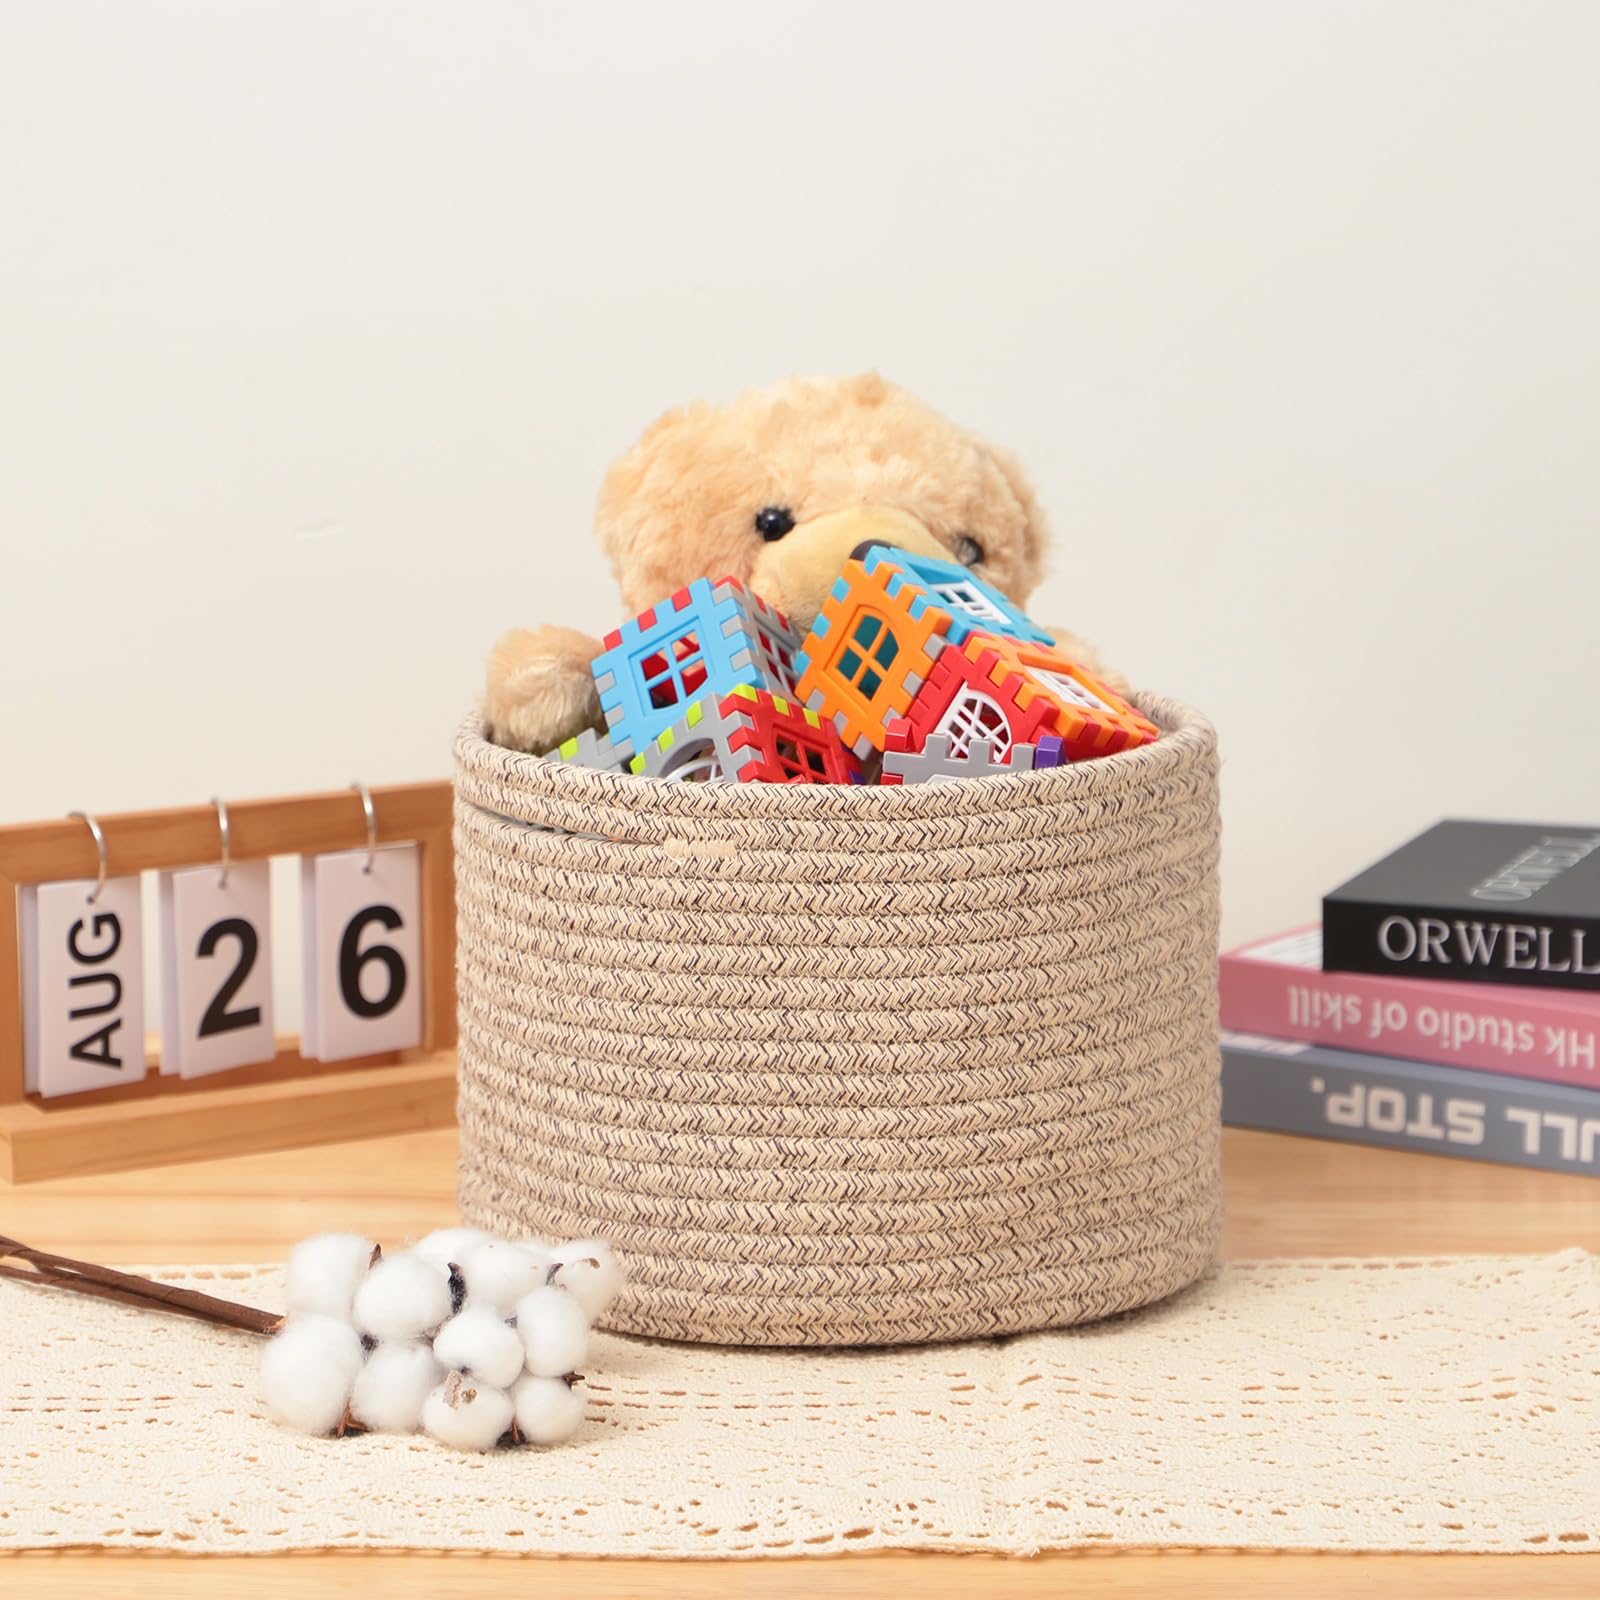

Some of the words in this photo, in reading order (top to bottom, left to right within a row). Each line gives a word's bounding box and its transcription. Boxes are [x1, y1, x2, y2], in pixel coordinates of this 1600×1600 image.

[338, 905, 407, 1019] 6
[1378, 915, 1600, 975] ORWELL
[68, 912, 123, 1069] AUG
[196, 918, 261, 1040] 2
[1287, 986, 1362, 1032] skill
[1368, 1001, 1408, 1038] of
[1416, 1006, 1535, 1054] studio
[1546, 1026, 1596, 1070] Hk
[1310, 1077, 1486, 1146] STOP.
